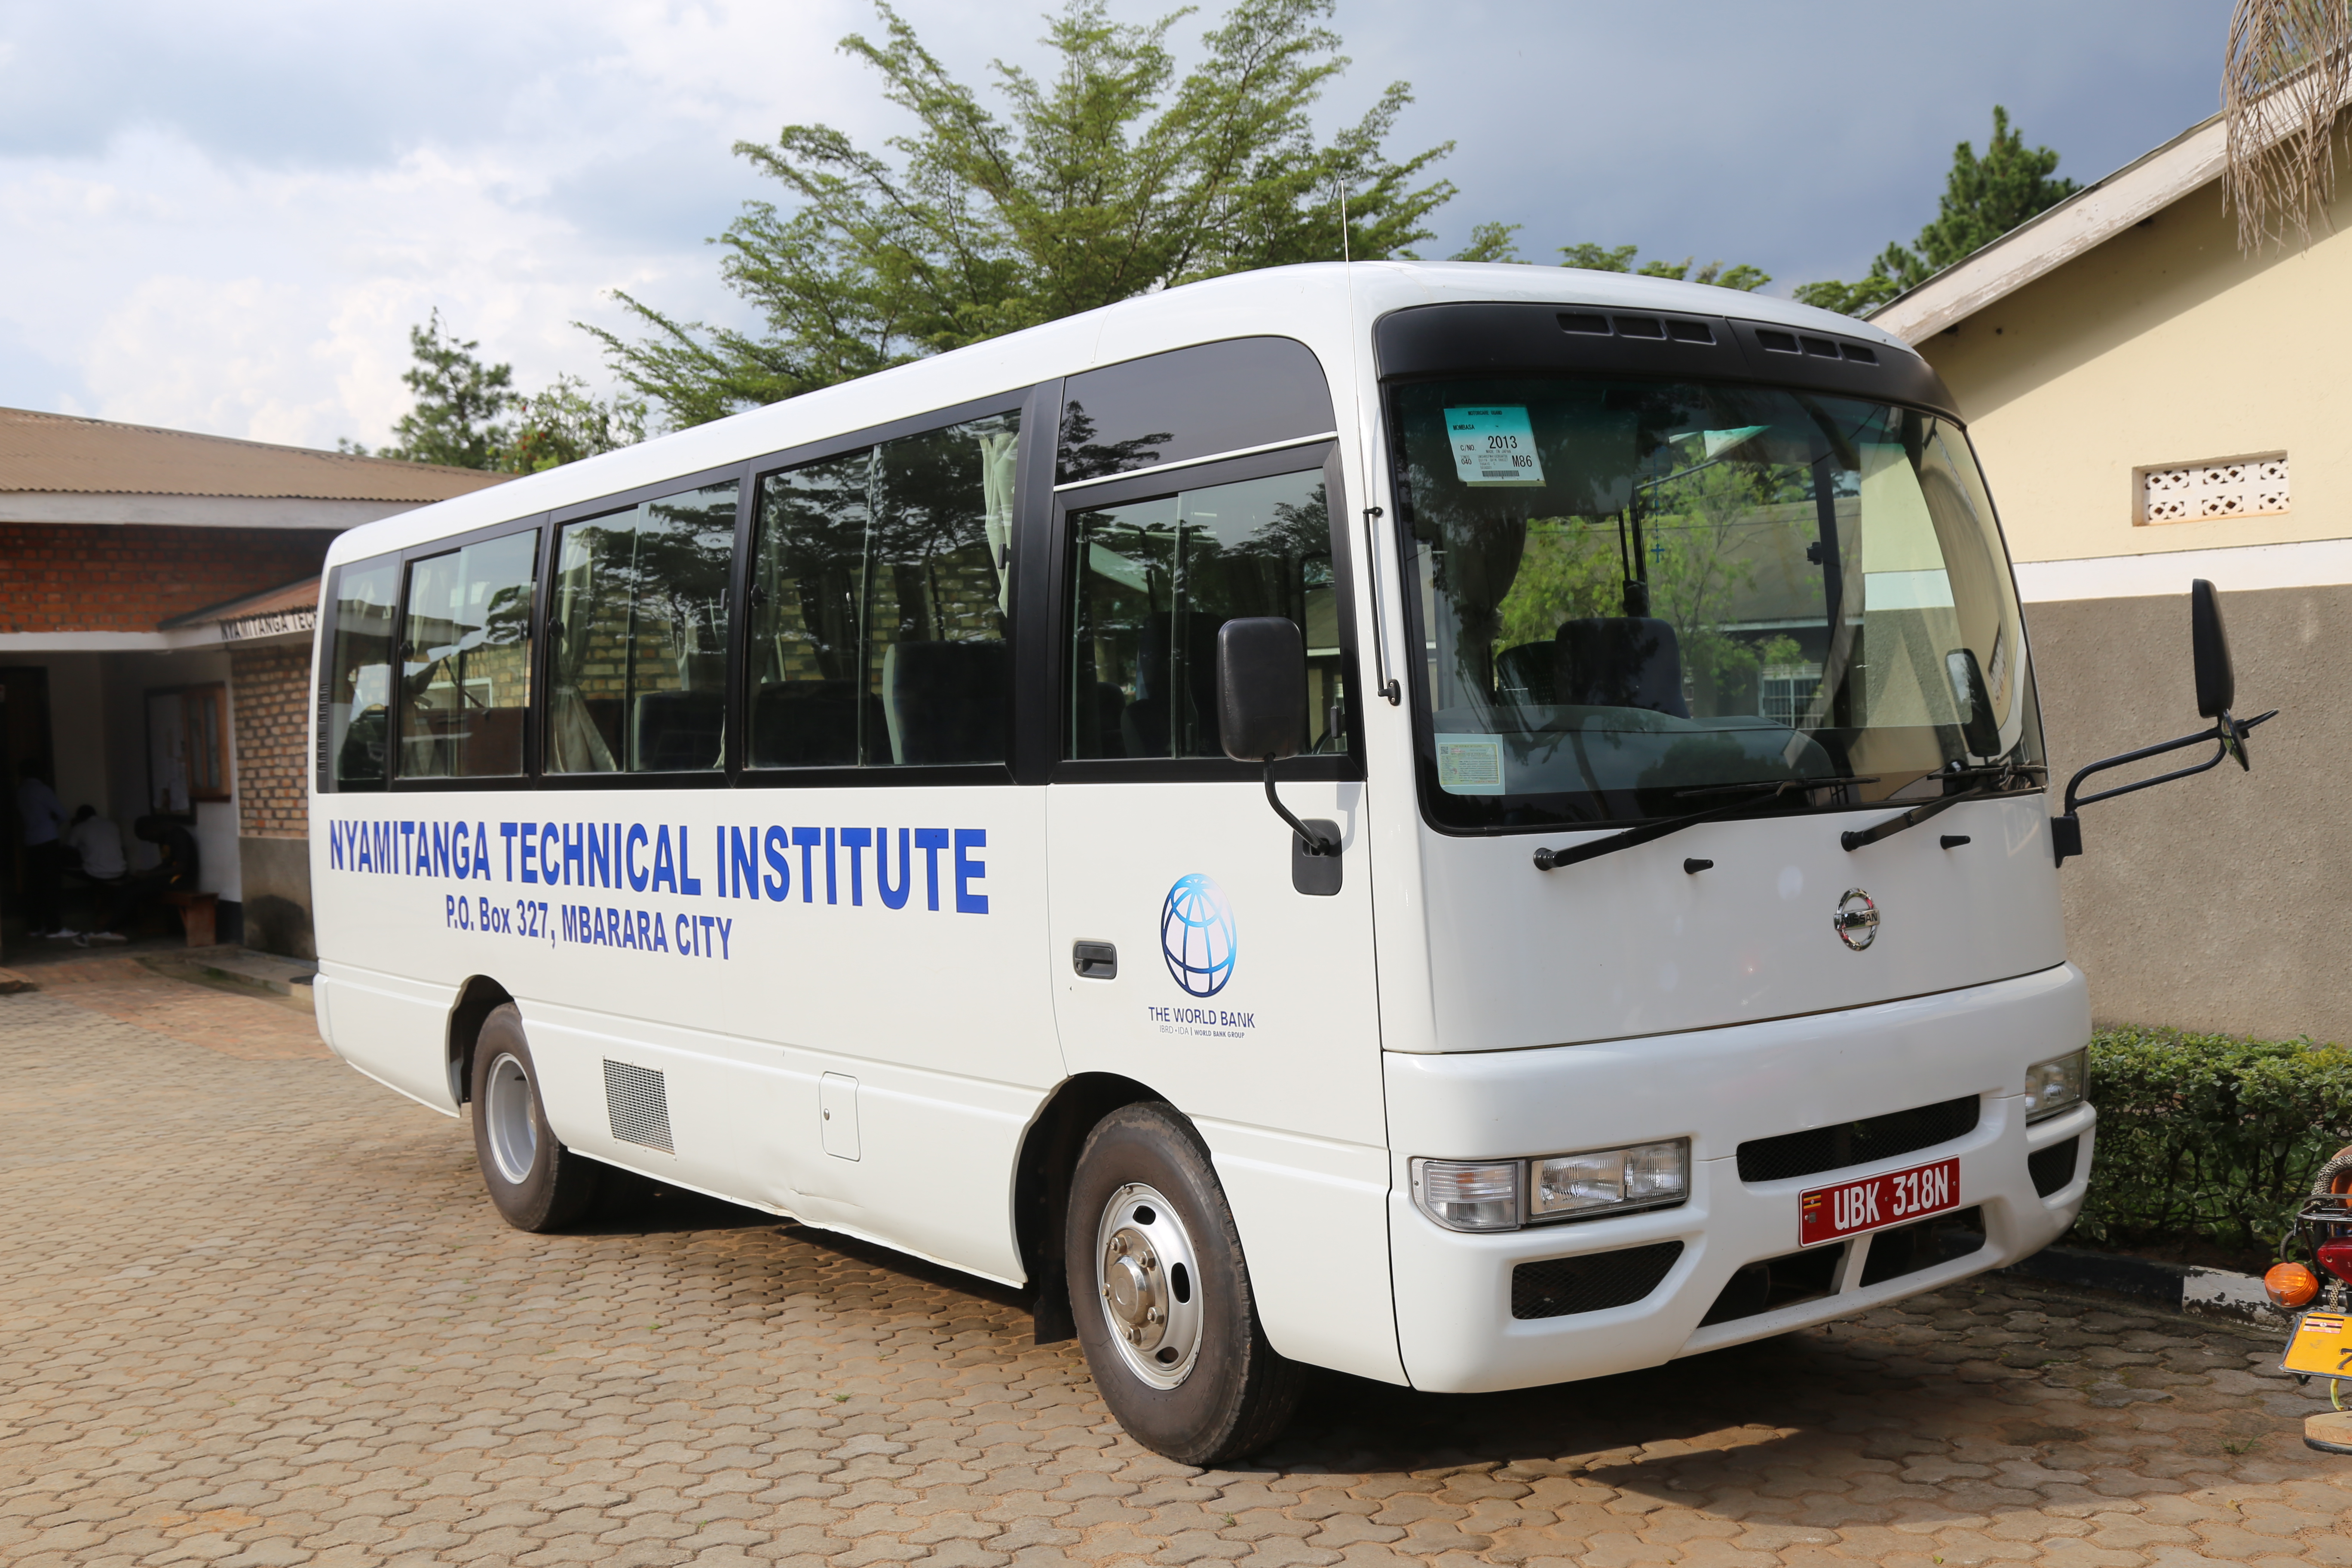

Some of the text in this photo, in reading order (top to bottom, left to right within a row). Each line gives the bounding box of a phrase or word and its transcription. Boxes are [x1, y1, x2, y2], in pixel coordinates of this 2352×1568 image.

[1488, 435, 1517, 449] 2013
[1512, 455, 1532, 467] M86
[330, 820, 989, 915] NYAMITANGA TECHNICAL INSTITUTE
[446, 894, 732, 960] P.O. Box 327, MBARARA CITY
[1841, 913, 1878, 925] NISSAN
[1148, 1006, 1256, 1029] THE WORLD BANK
[1159, 1025, 1174, 1034] IBRD
[1178, 1027, 1189, 1035] IDA
[1834, 1165, 1948, 1230] UBK 318N
